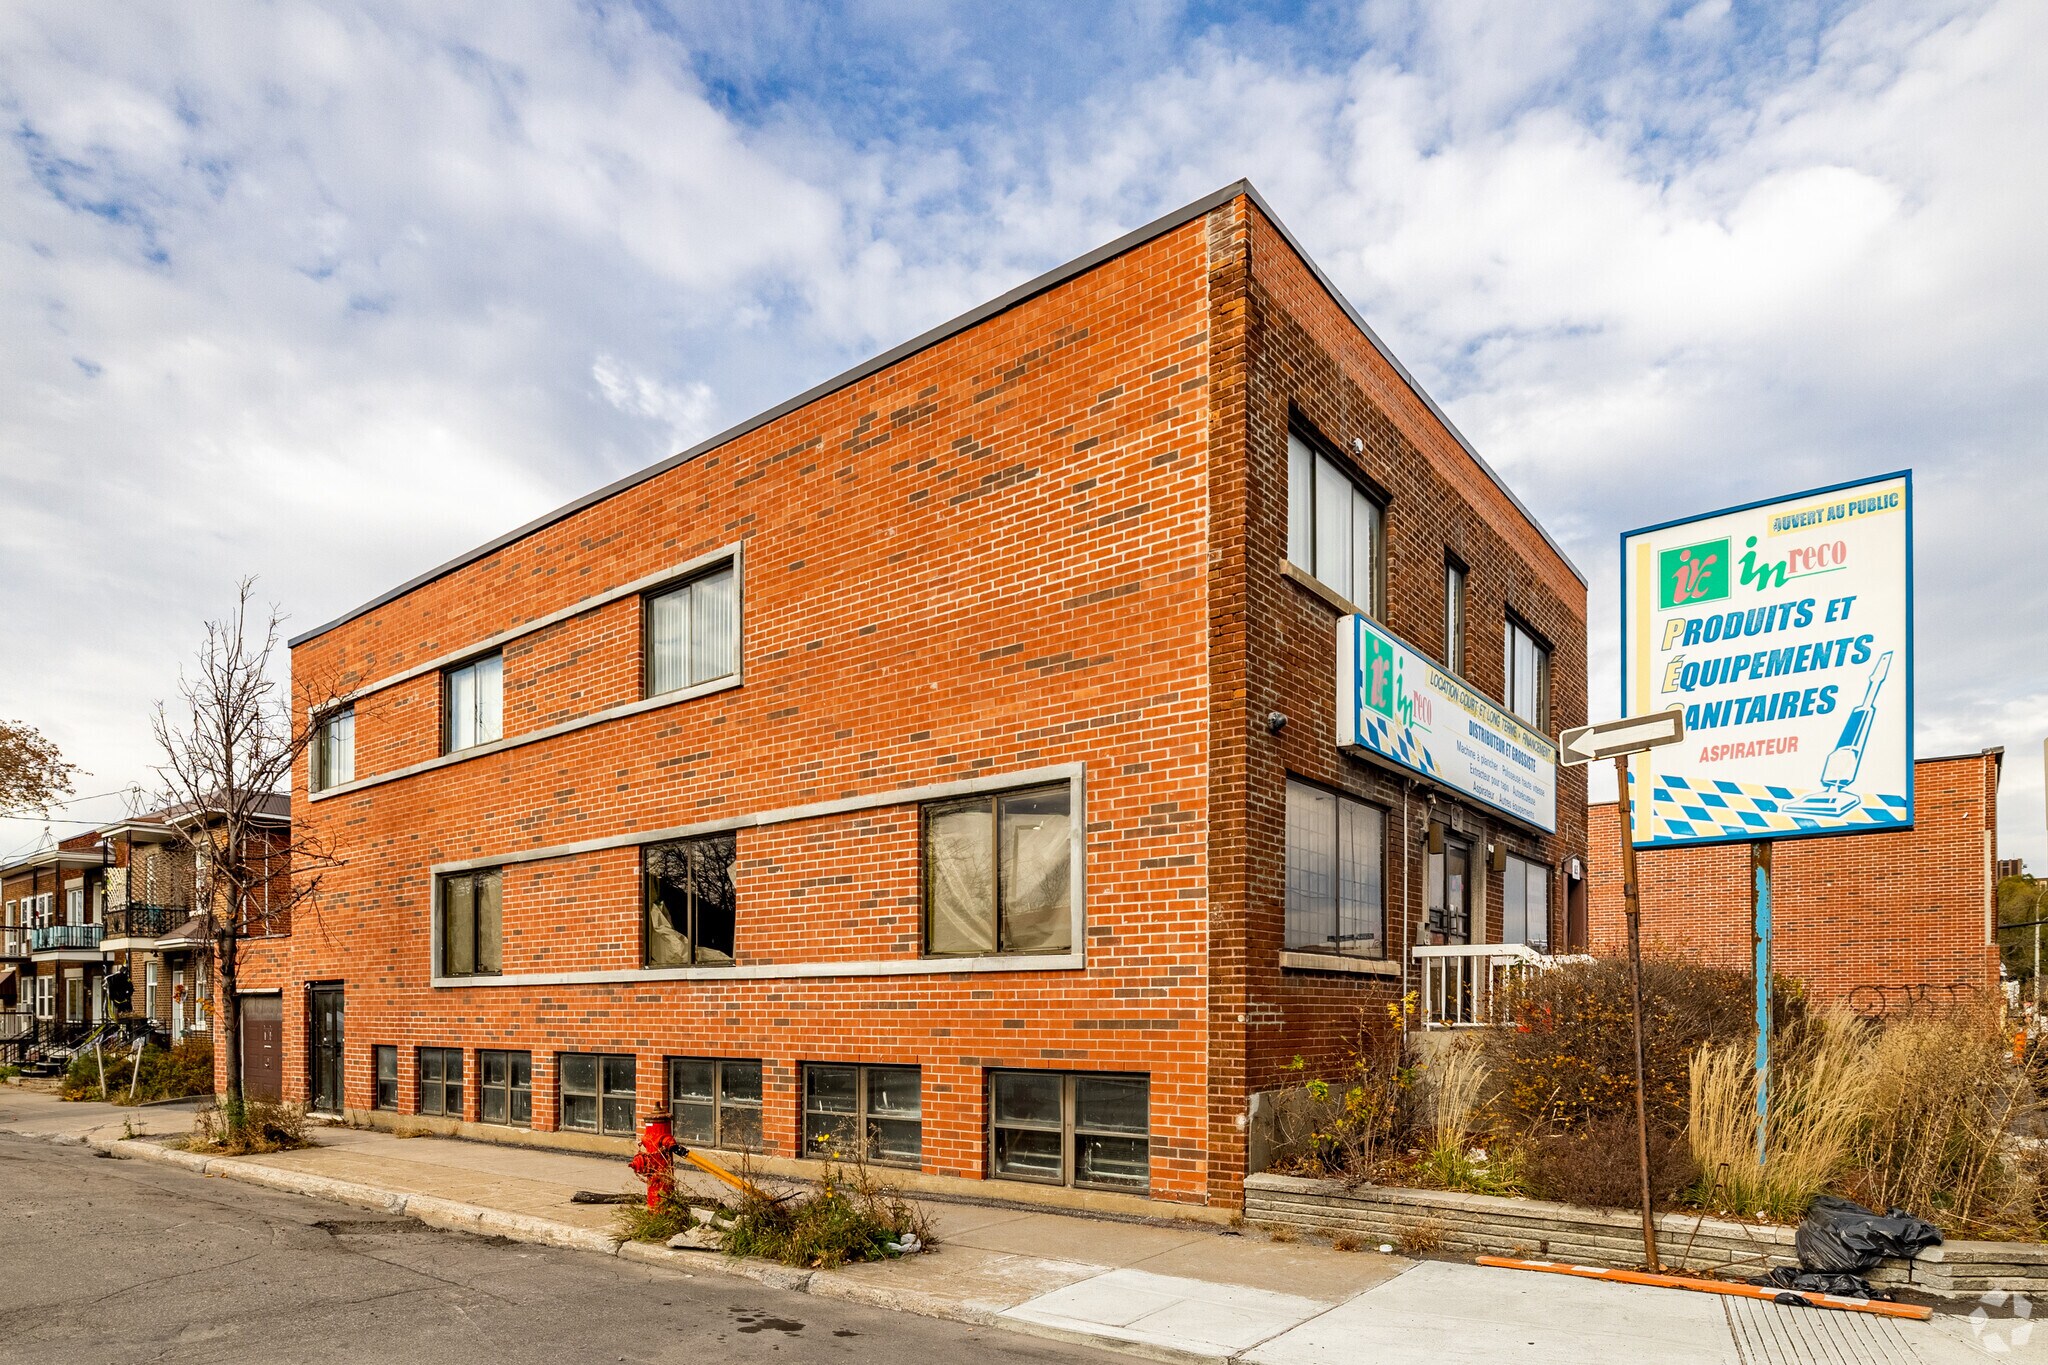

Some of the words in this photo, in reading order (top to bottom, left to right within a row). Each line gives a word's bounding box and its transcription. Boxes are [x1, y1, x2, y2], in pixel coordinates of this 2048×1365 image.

[1773, 509, 1824, 532] OUVERT
[1826, 503, 1845, 521] AU
[1848, 492, 1899, 516] PUBLIC
[1738, 535, 1847, 592] inreco
[1661, 598, 1816, 651] PRODUITS
[1824, 595, 1857, 623] ET
[1661, 634, 1875, 694] ÉQUIPEMENTS
[1430, 670, 1459, 703] LOCATION
[1460, 691, 1478, 712] COURT
[1479, 703, 1486, 718] ET
[1487, 709, 1500, 727] LONG
[1522, 732, 1551, 758] FINANCEMENT
[1457, 739, 1476, 760] Machine
[1469, 719, 1505, 755] DISTRIBUTEUR
[1506, 742, 1511, 758] ET
[1511, 746, 1536, 773] GROSSISTE
[1699, 735, 1800, 764] ASPIRATEUR
[1470, 762, 1490, 782] Extracteur
[1473, 780, 1494, 801] Aspirateur
